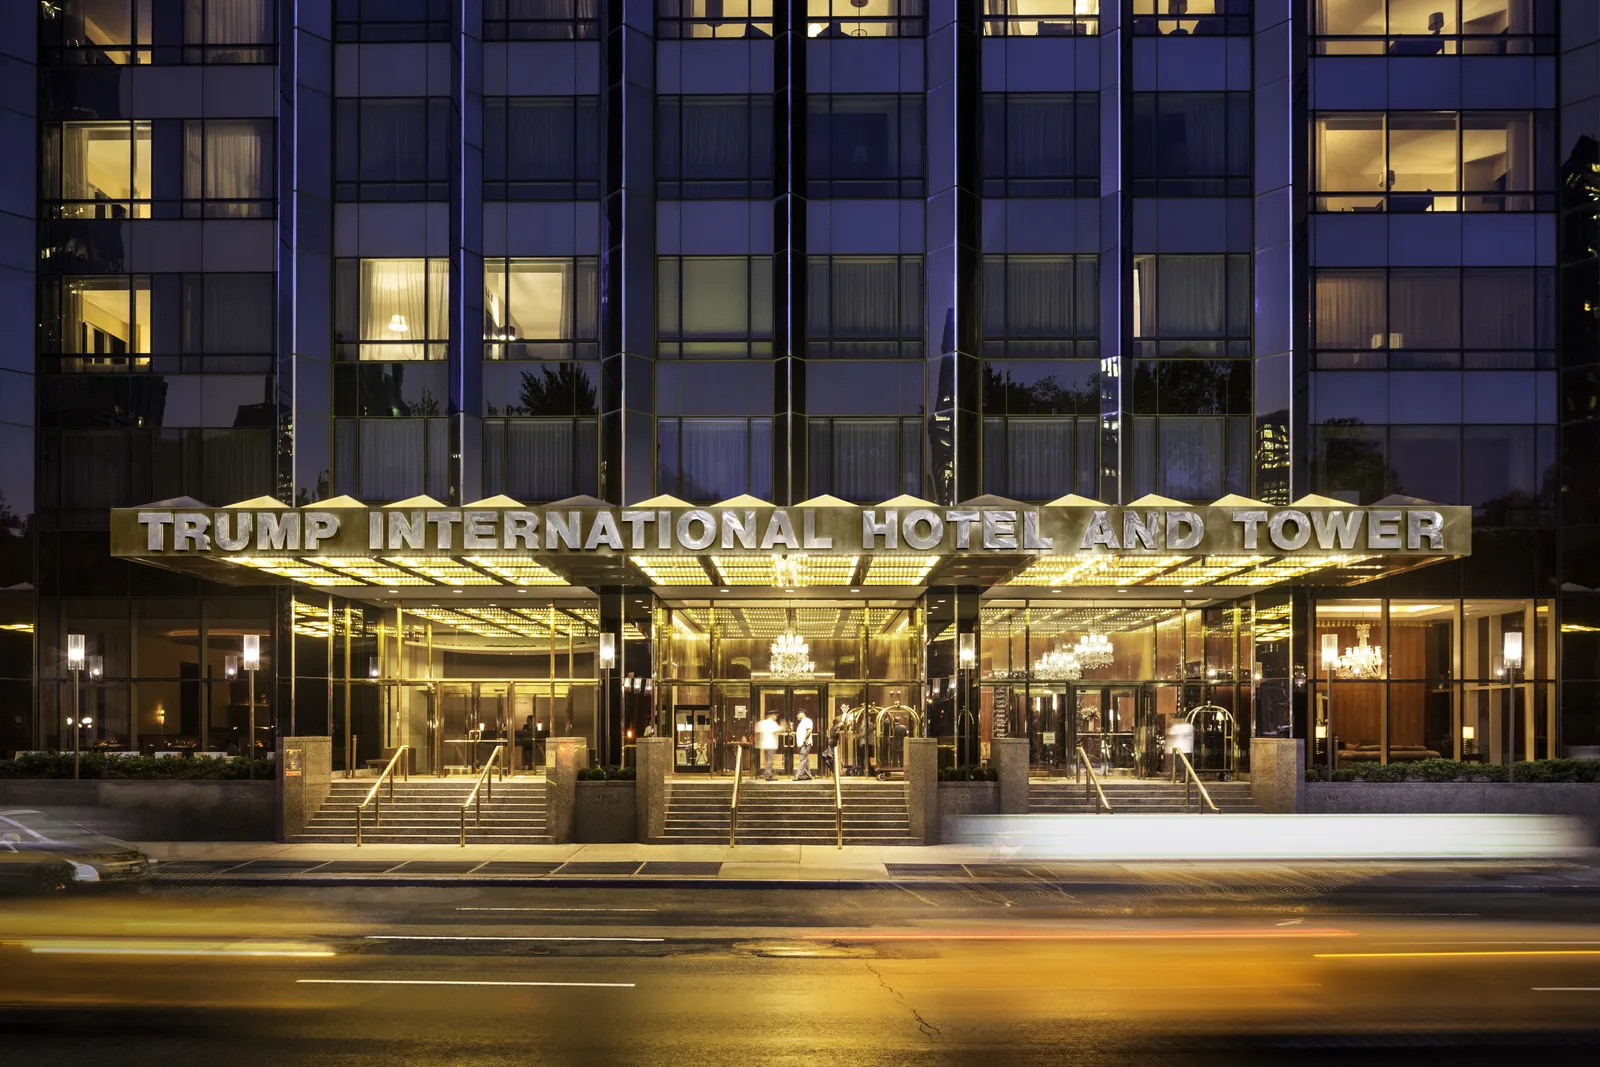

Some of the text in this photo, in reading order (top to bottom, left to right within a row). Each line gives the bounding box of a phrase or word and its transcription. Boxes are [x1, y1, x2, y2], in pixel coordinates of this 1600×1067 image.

[137, 509, 1445, 551] TRUMP INTERNATIONAL HOTEL AND TOWER
